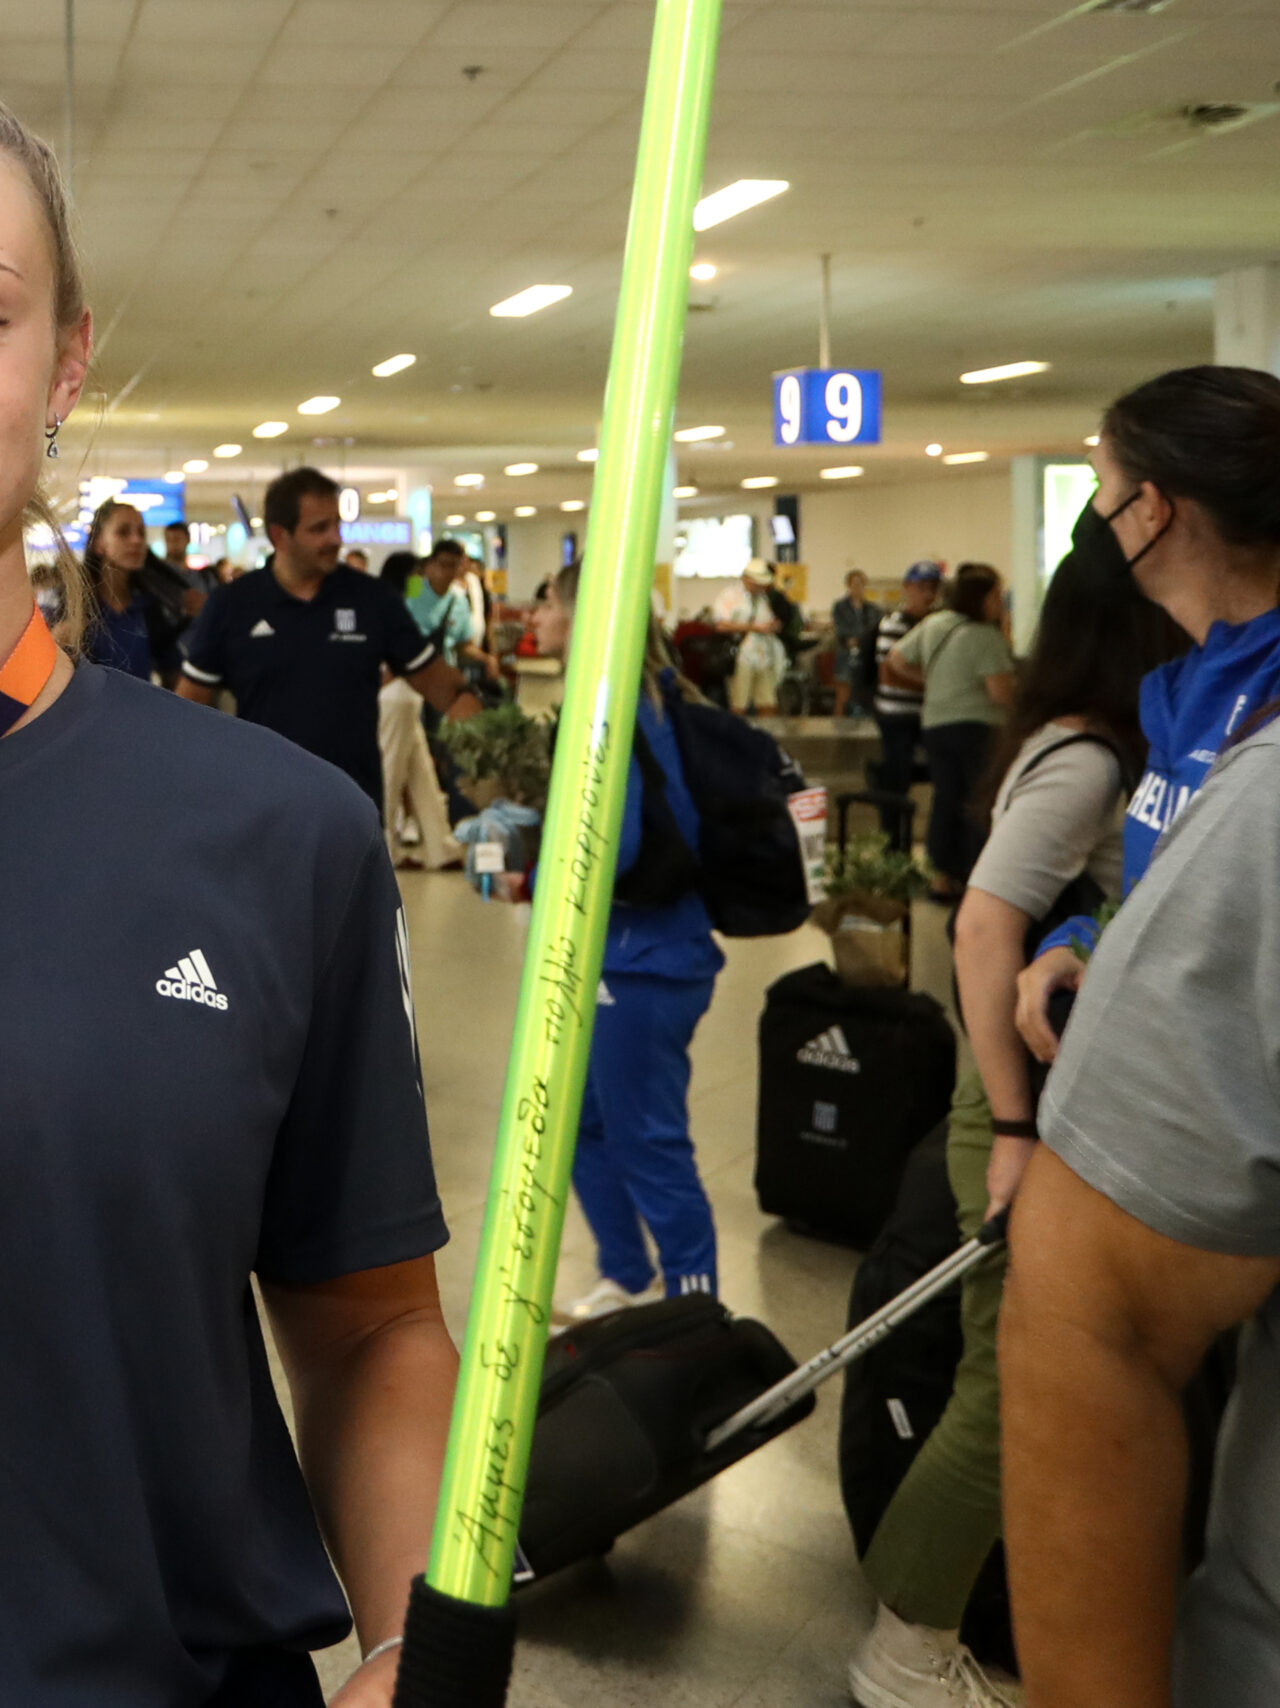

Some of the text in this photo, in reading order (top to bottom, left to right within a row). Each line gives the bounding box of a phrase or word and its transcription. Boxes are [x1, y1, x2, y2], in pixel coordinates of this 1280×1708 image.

[780, 376, 800, 444] 9
[825, 372, 862, 442] 9
[155, 978, 229, 1011] adidas
